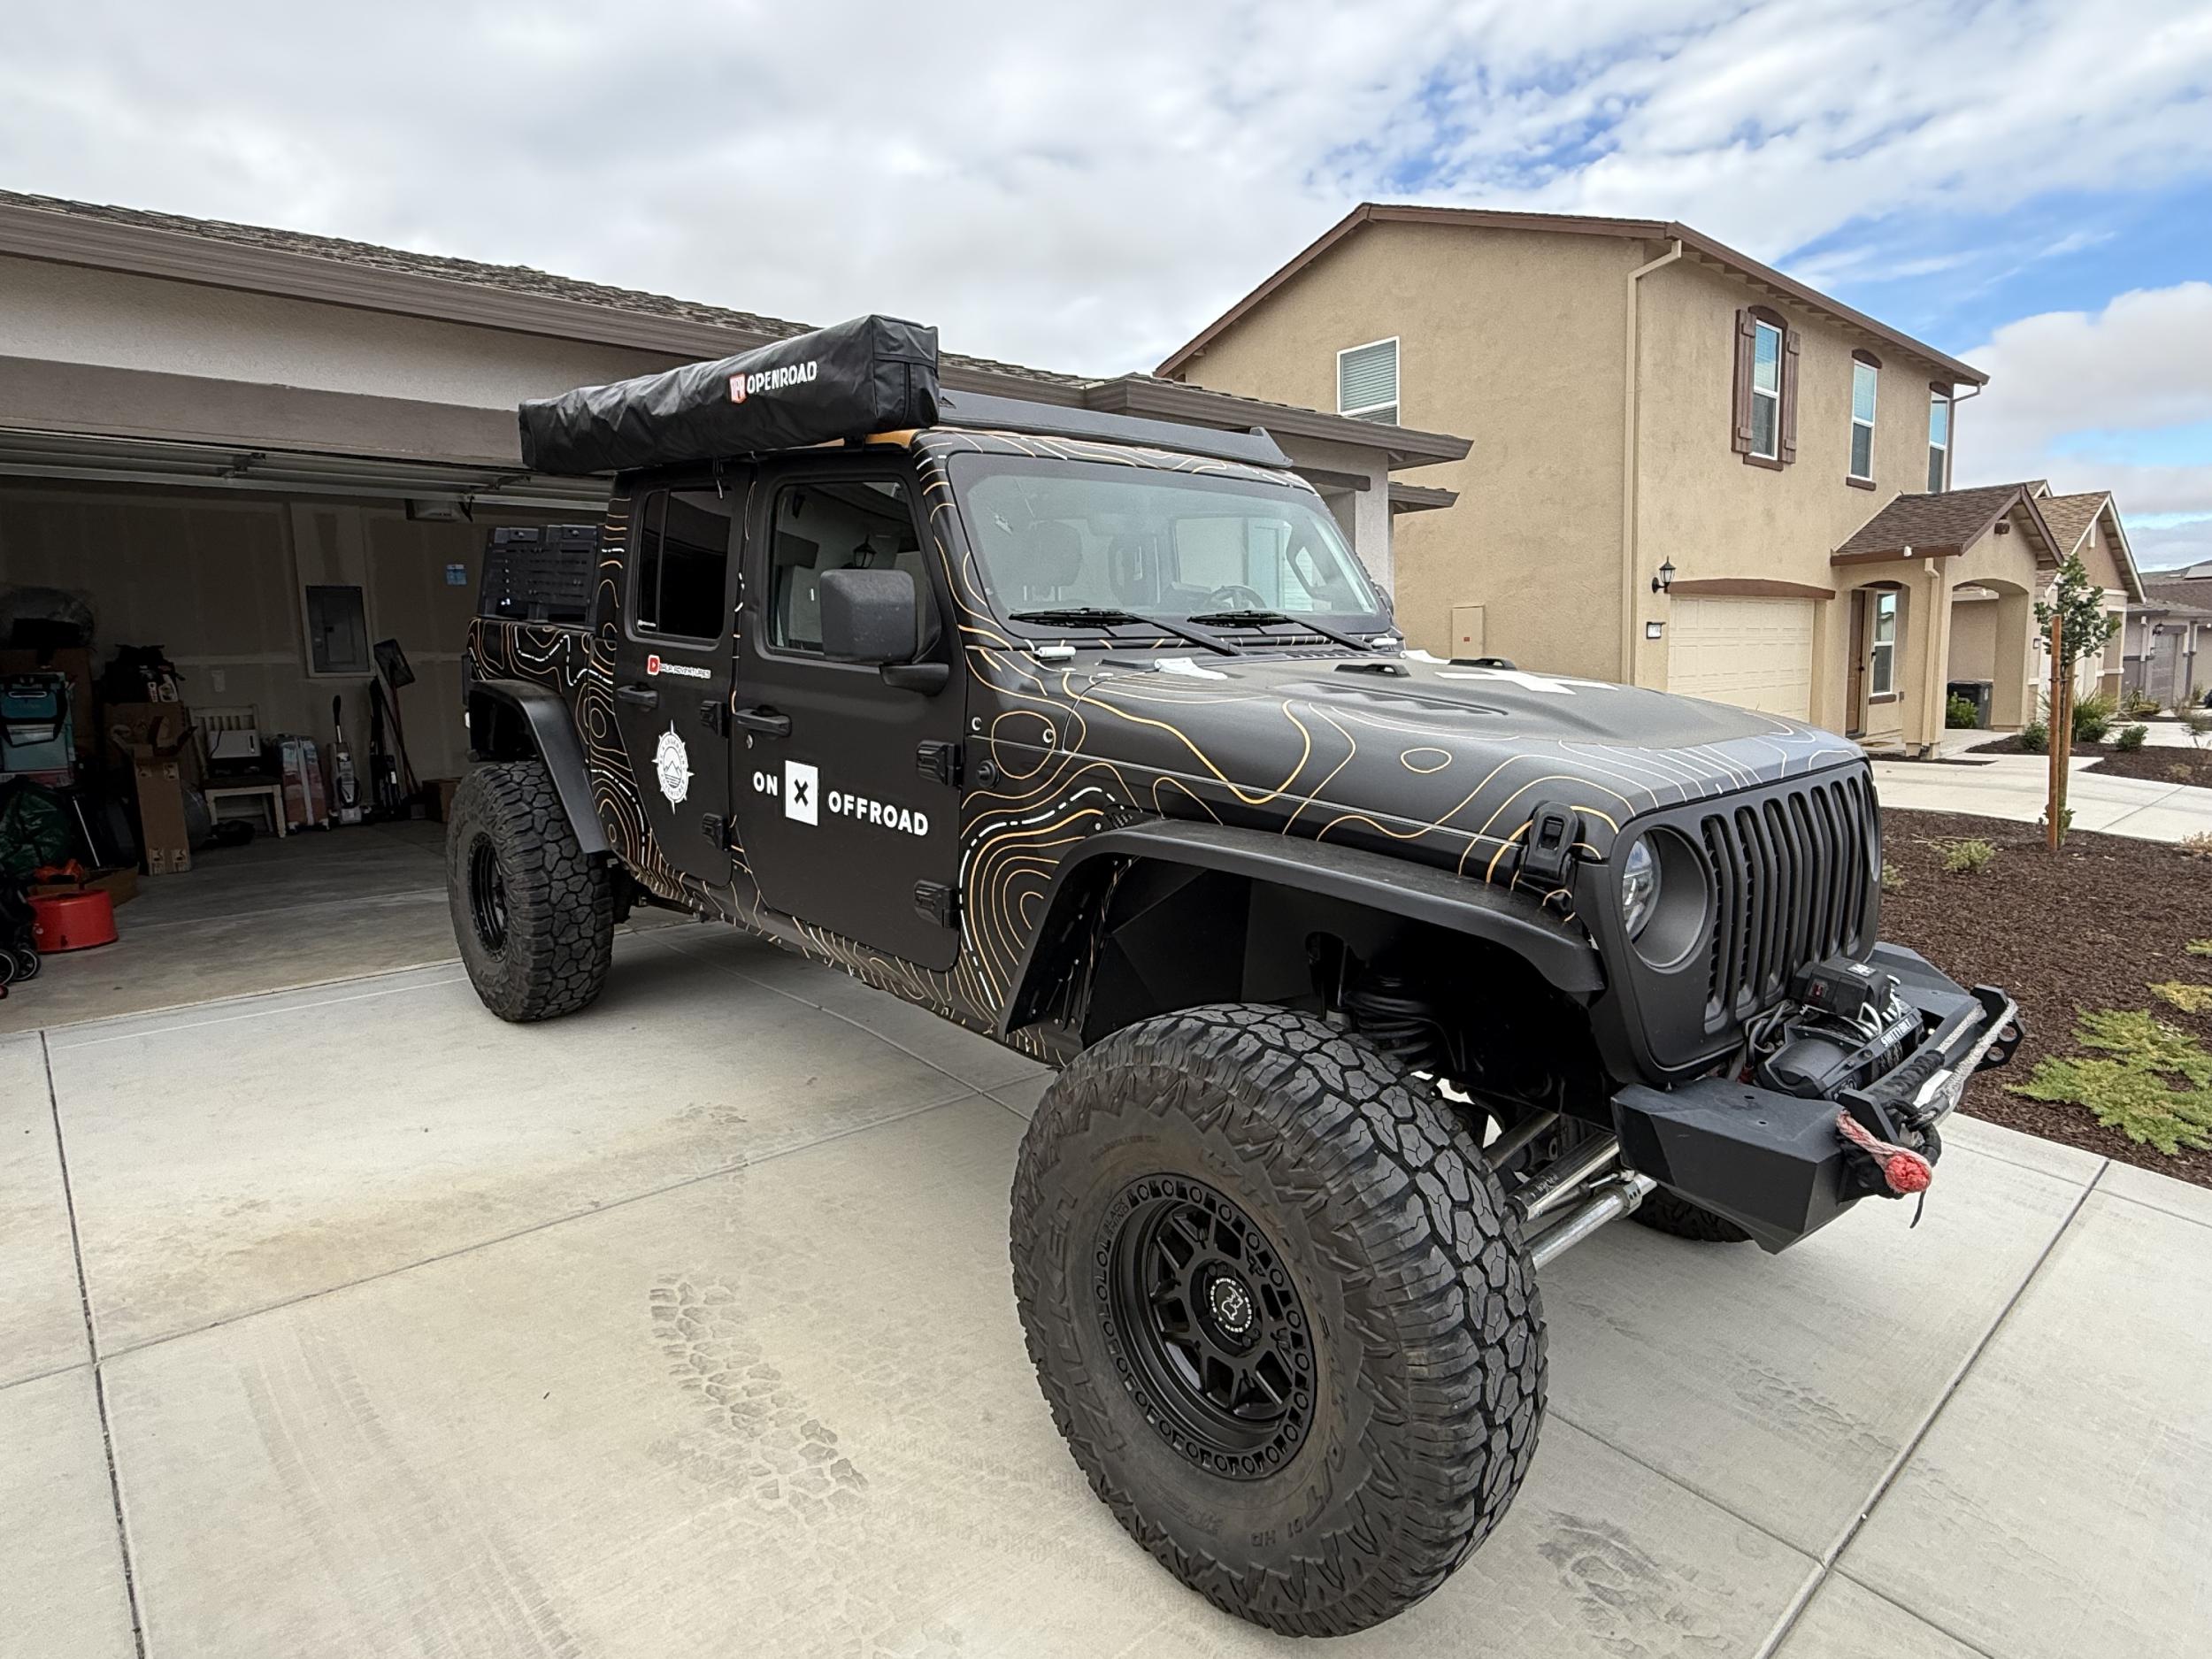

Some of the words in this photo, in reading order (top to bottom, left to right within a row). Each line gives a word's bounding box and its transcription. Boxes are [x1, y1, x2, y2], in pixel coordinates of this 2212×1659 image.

[746, 361, 817, 394] OPENROAD
[753, 772, 779, 796] ON
[794, 779, 810, 807] X
[828, 791, 929, 836] OFFROAD
[1103, 1197, 1125, 1233] BLACK
[1108, 1204, 1130, 1238] RHINO
[1048, 1183, 1127, 1462] FALKEN
